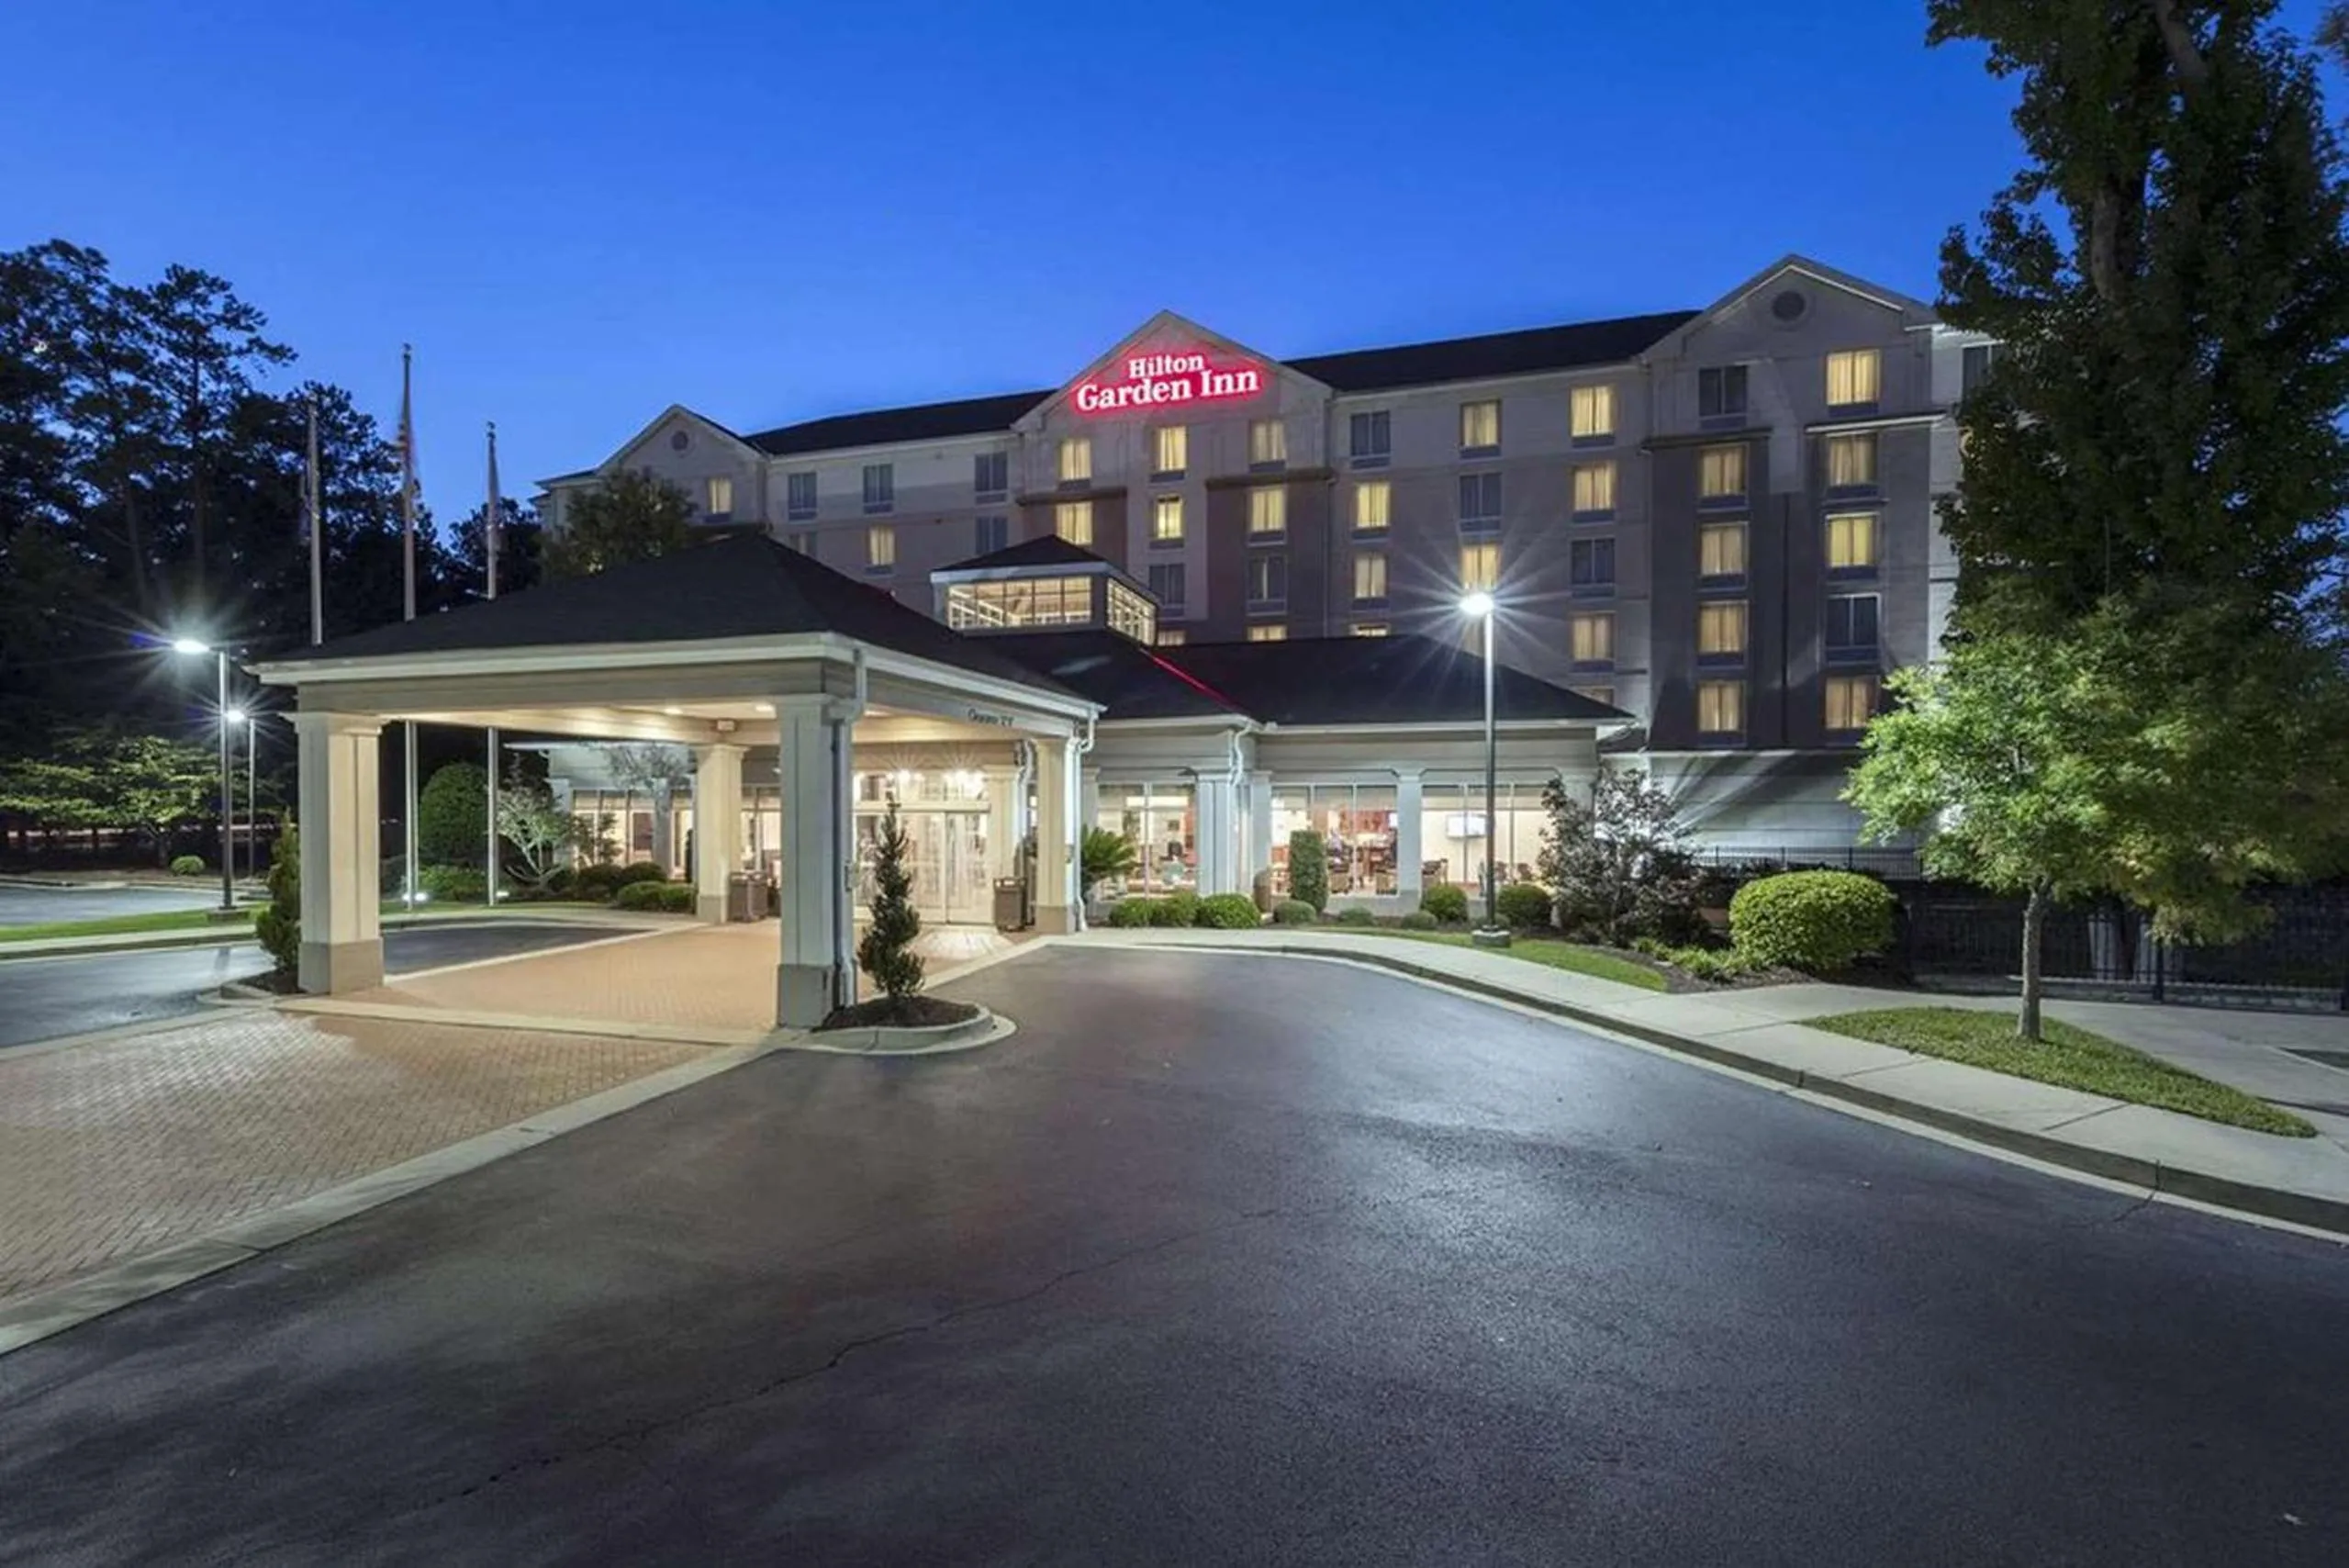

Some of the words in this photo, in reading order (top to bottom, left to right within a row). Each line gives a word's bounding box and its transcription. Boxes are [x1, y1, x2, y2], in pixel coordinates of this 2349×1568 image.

[1129, 354, 1204, 378] Hilton
[1077, 378, 1192, 410] Garden
[1200, 370, 1258, 397] Inn
